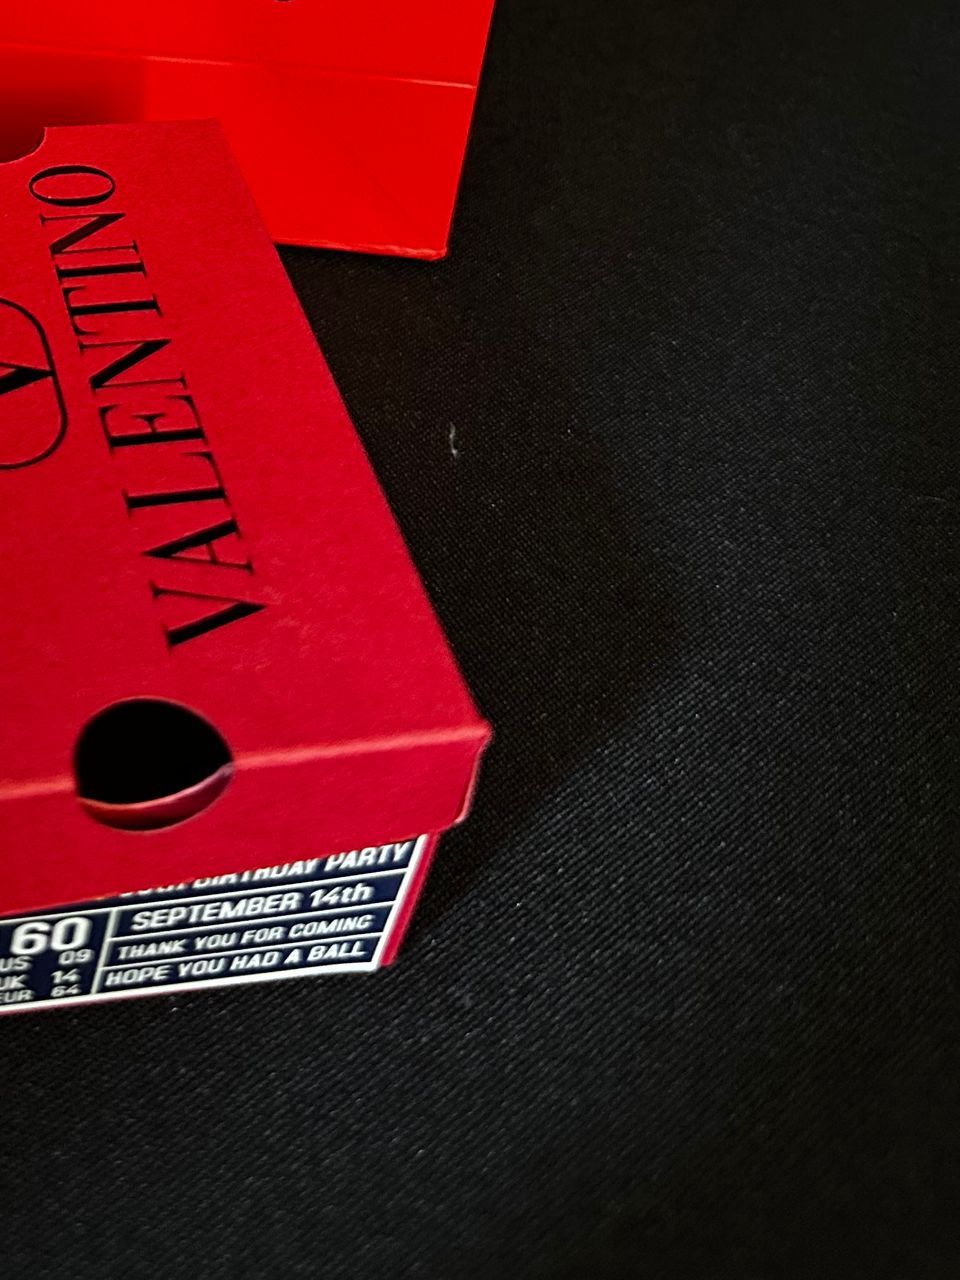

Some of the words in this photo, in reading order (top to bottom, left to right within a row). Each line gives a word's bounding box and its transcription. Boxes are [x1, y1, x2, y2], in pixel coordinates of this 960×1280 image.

[29, 164, 269, 653] VALENTINO
[324, 840, 412, 872] PARTY
[131, 891, 302, 931] SEPTEMBER
[309, 881, 375, 909] 14th
[10, 917, 90, 955] 60
[117, 938, 188, 961] THANK
[195, 930, 240, 949] YOU
[241, 924, 286, 944] FOR
[288, 913, 376, 938] COMING
[50, 967, 81, 984] 14
[57, 948, 94, 966] 09
[104, 963, 172, 987] HOPE
[178, 956, 227, 978] YOU
[229, 949, 281, 970] HAD
[284, 948, 302, 964] A
[306, 939, 368, 962] BALL
[50, 983, 81, 998] 64
